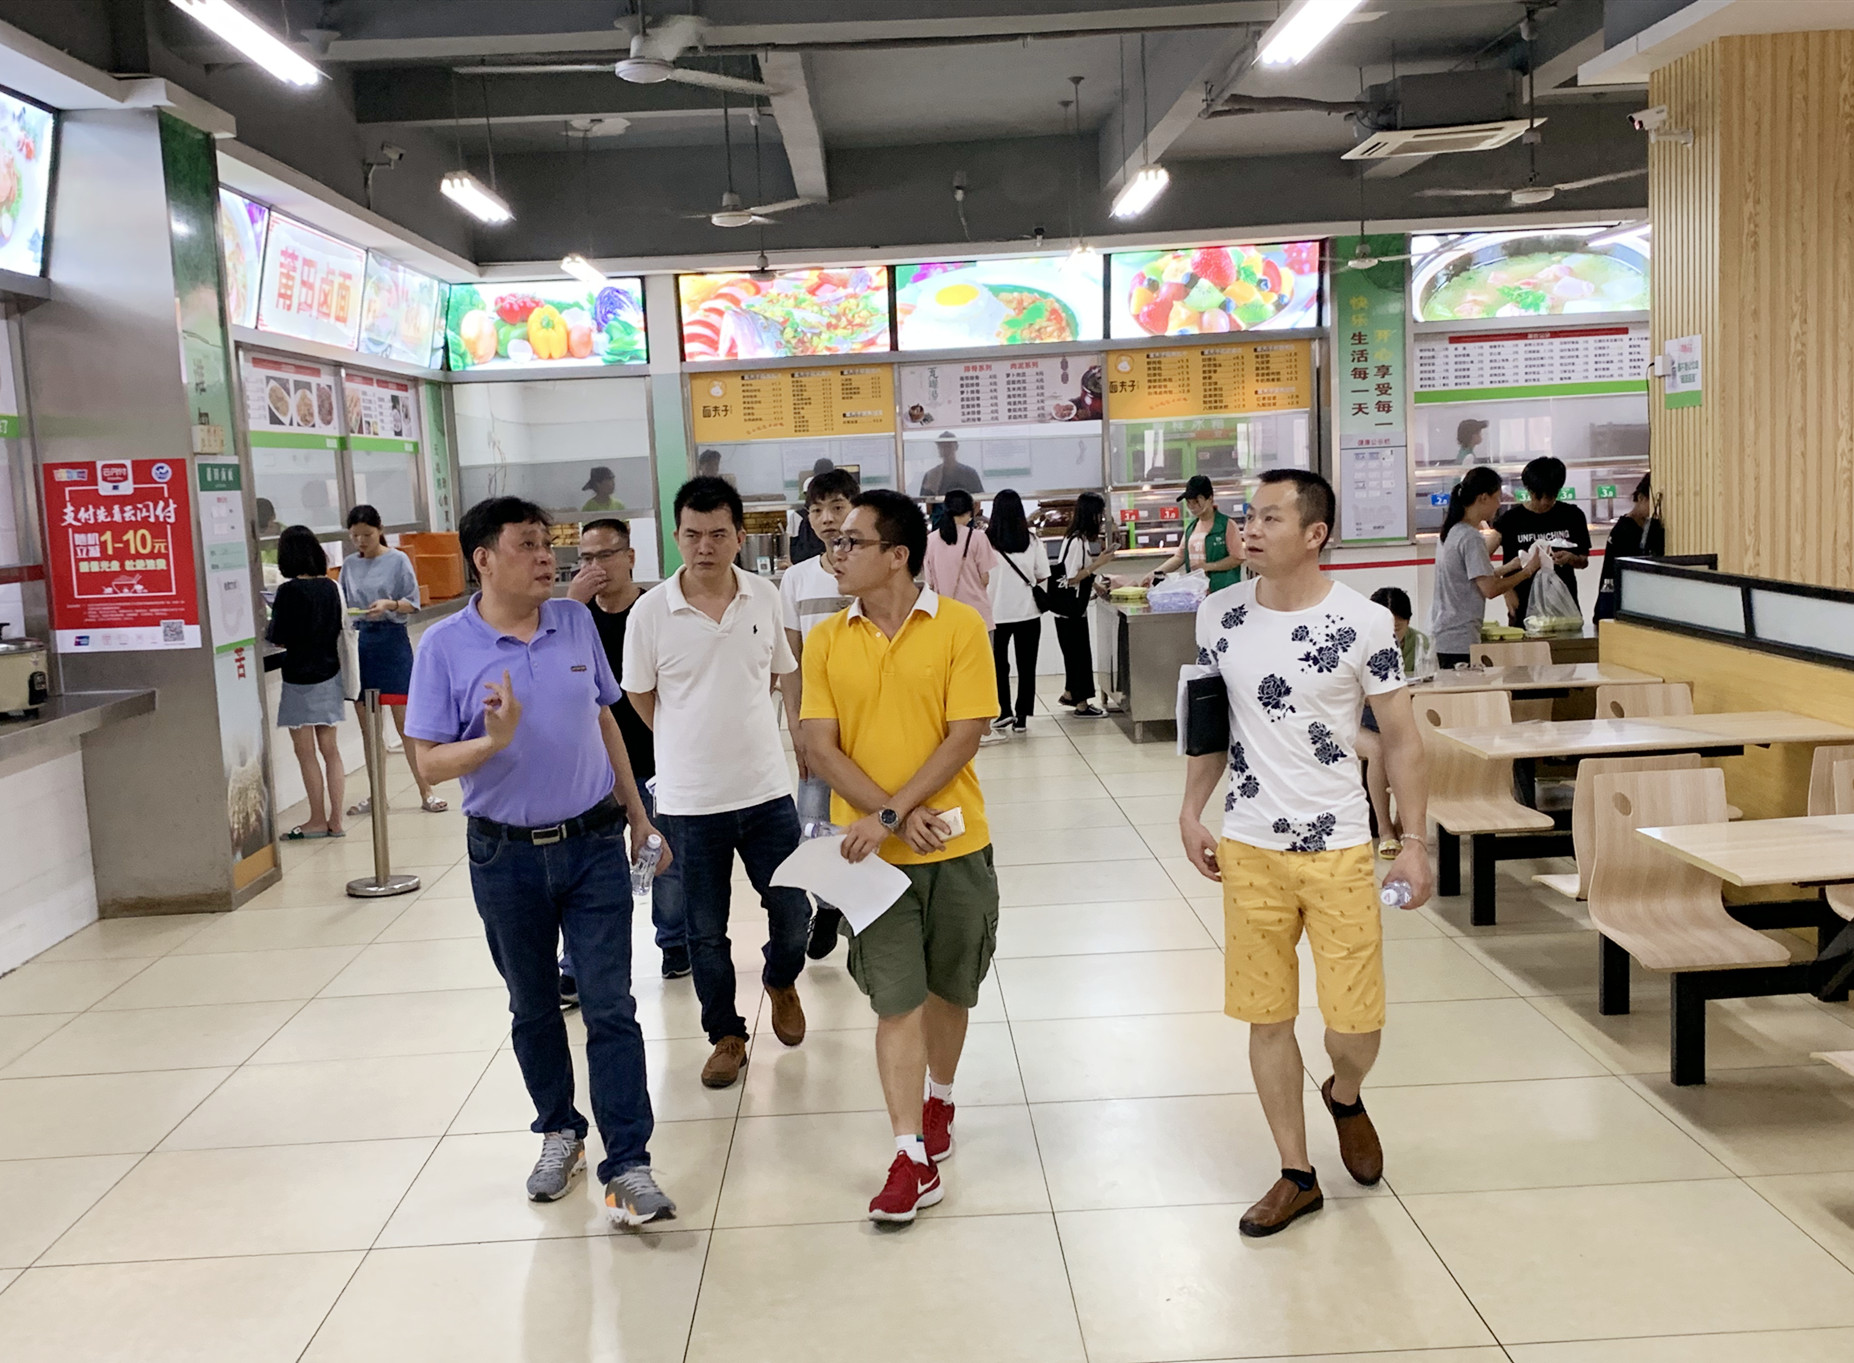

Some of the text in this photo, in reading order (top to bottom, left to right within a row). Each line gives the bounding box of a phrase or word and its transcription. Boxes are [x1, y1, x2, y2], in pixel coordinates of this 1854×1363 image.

[1109, 380, 1137, 393] 面夫子
[702, 404, 729, 418] 面夫子
[61, 499, 177, 526] 支付先看云闪付
[1517, 529, 1570, 543] UNFLINCHING
